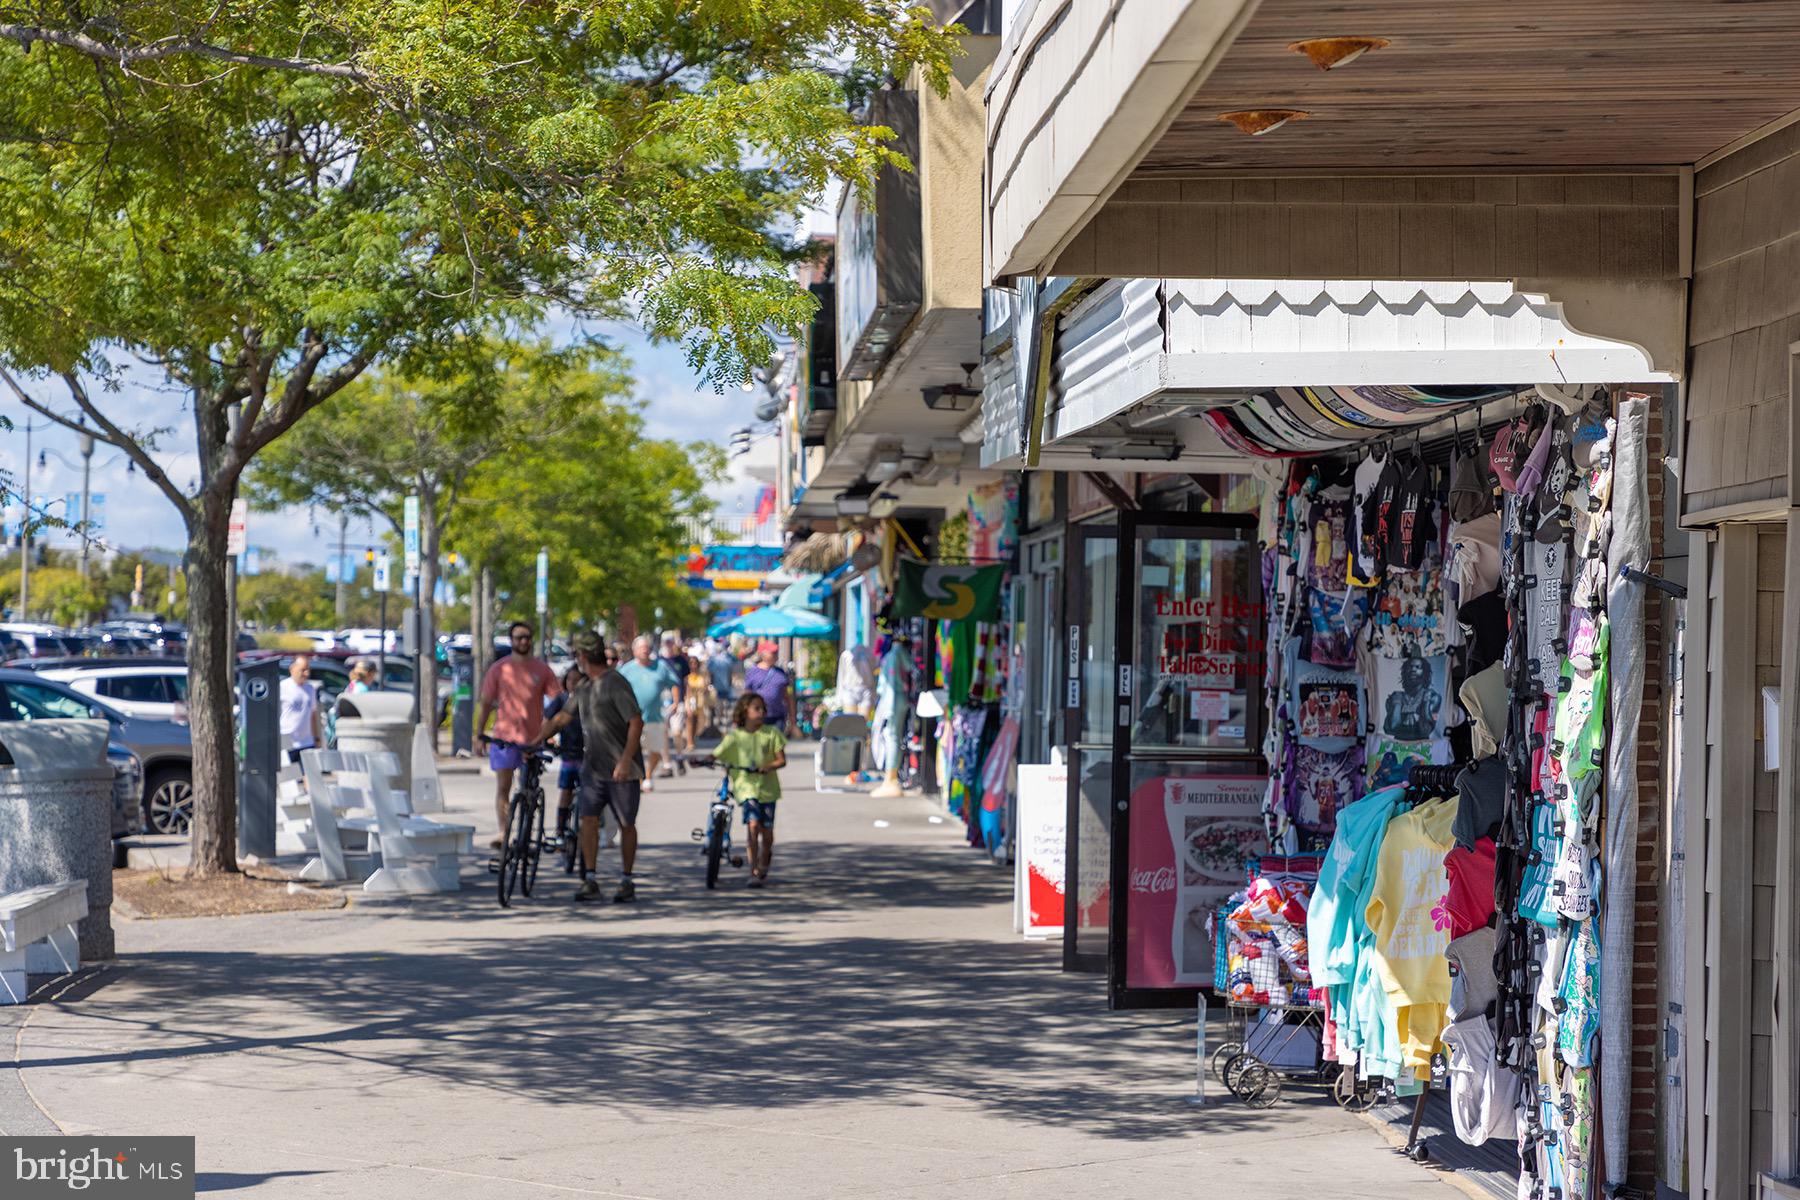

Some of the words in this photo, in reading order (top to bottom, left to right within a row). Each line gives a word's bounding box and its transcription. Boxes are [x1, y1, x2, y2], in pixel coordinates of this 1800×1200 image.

[1155, 593, 1215, 616] Enter
[1157, 656, 1205, 675] Table
[1187, 792, 1260, 805] MEDITERRANEAN
